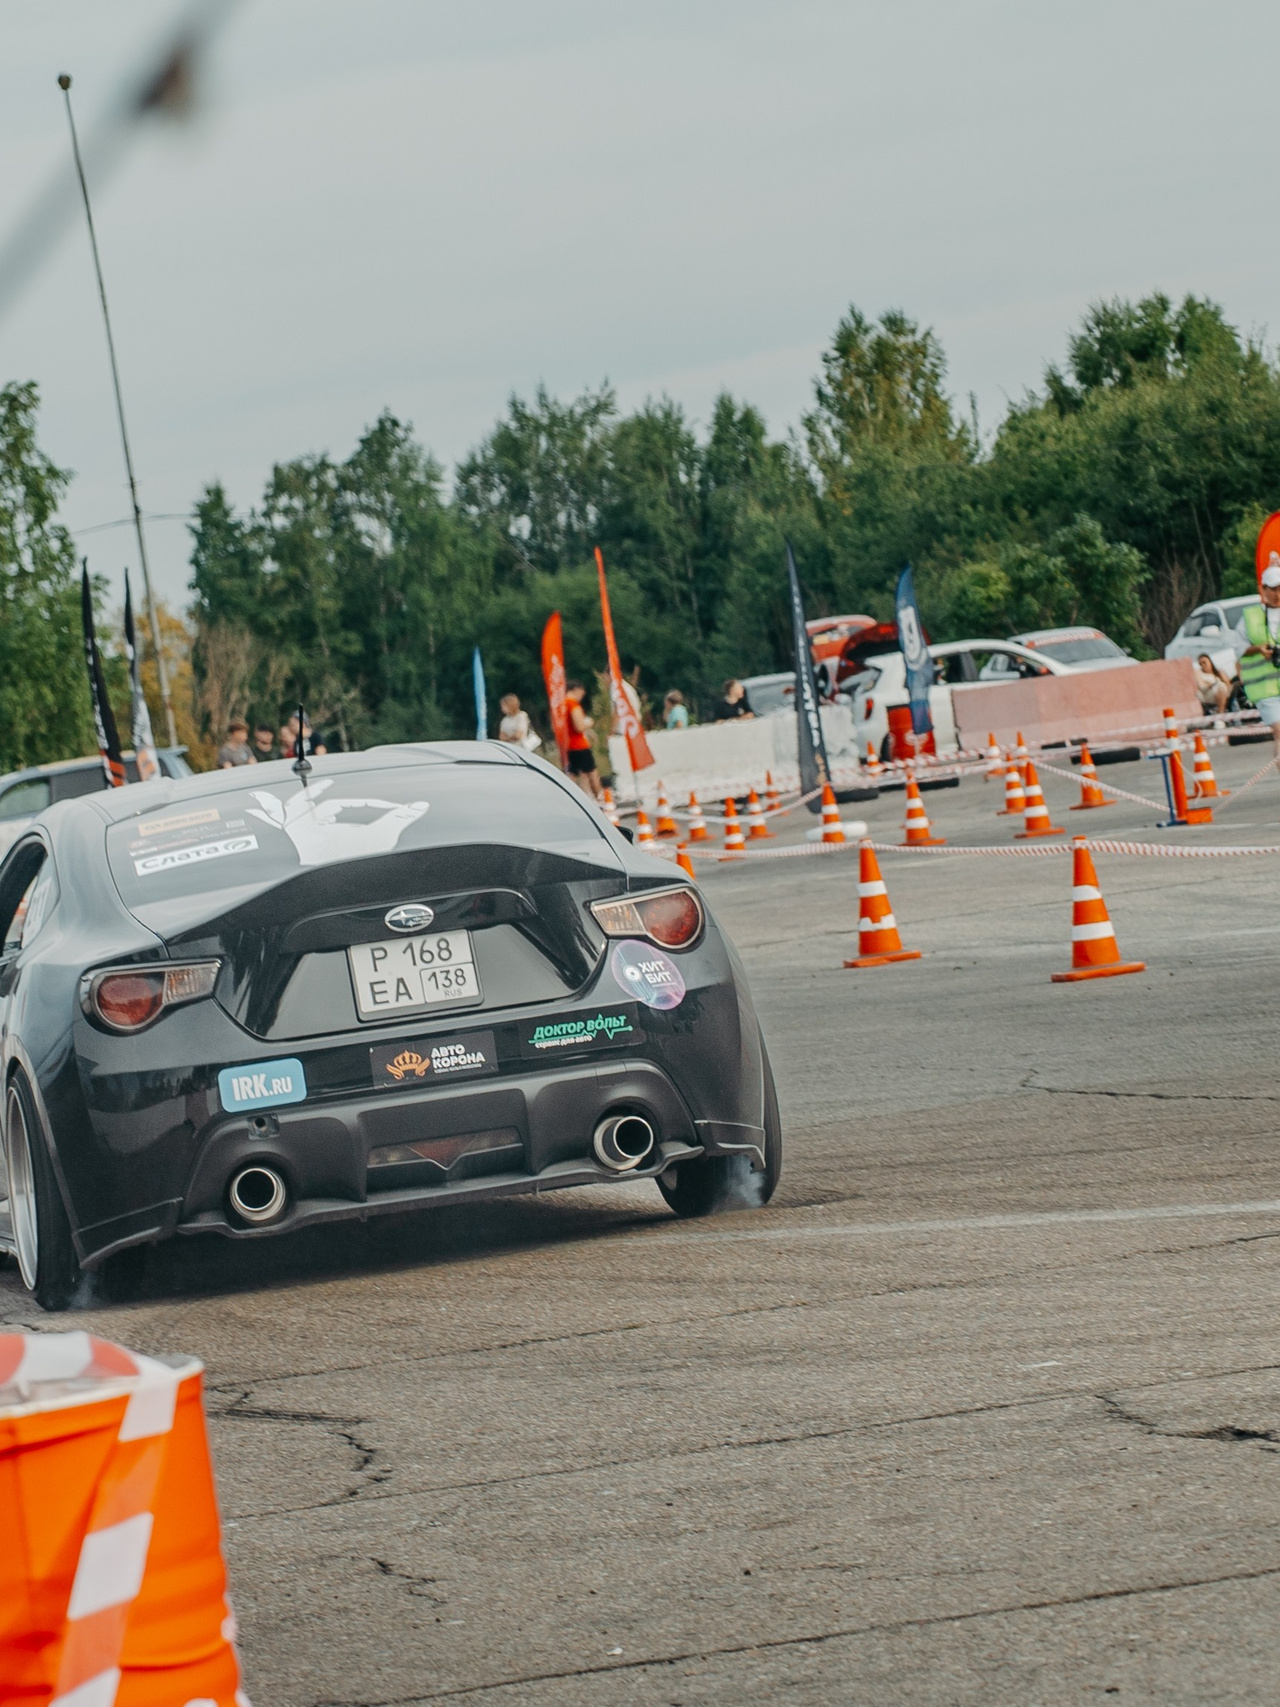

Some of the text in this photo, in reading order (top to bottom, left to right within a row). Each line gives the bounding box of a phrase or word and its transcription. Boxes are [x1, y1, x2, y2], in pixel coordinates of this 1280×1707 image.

[402, 937, 453, 967] 168
[637, 960, 666, 974] ХИТ
[427, 967, 467, 991] 138
[644, 971, 673, 985] БИТ
[443, 987, 463, 998] RUS
[533, 1014, 628, 1041] ДОКТОР ВОЛЬТ
[431, 1043, 466, 1059] АВТО
[432, 1051, 487, 1070] КОРОНА
[231, 1072, 294, 1102] IRK.RU
